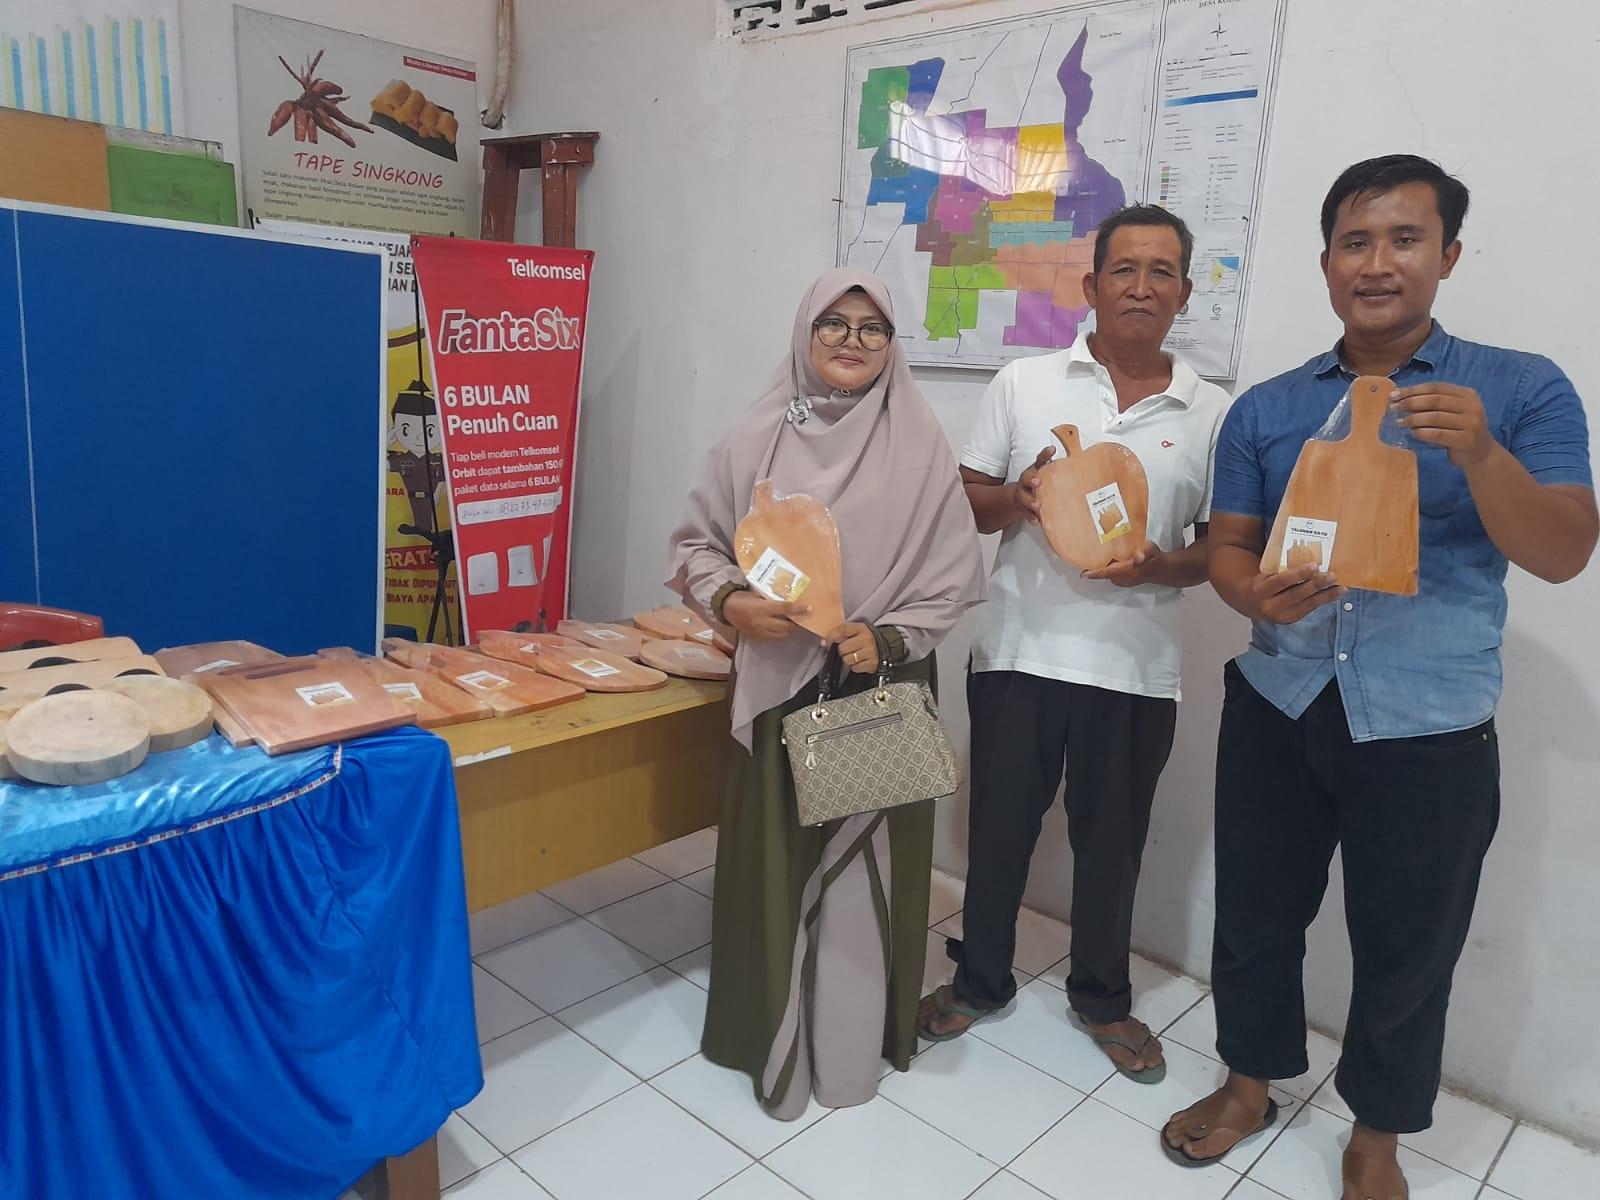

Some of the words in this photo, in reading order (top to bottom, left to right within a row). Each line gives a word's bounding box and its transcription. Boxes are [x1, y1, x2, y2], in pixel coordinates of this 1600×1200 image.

[294, 152, 344, 174] TAPE
[351, 161, 443, 188] SINGKONG
[507, 258, 586, 281] Telkomsel
[438, 306, 580, 354] FantaSix
[444, 386, 457, 408] 6
[460, 384, 530, 407] BULAN
[446, 411, 510, 436] Penuh
[512, 411, 559, 432] Cuan
[450, 452, 470, 462] Tiap
[470, 450, 487, 461] beli
[487, 449, 519, 459] modem
[519, 445, 560, 457] Telkomsel
[452, 467, 477, 479] Orbit
[477, 465, 501, 476] dapat
[502, 461, 544, 474] tambahan
[545, 459, 558, 470] 150
[454, 484, 479, 497] paket
[479, 482, 499, 492] data
[500, 479, 527, 490] selama
[527, 476, 534, 486] 6
[534, 474, 560, 485] BULAN
[386, 592, 413, 603] BIAYA
